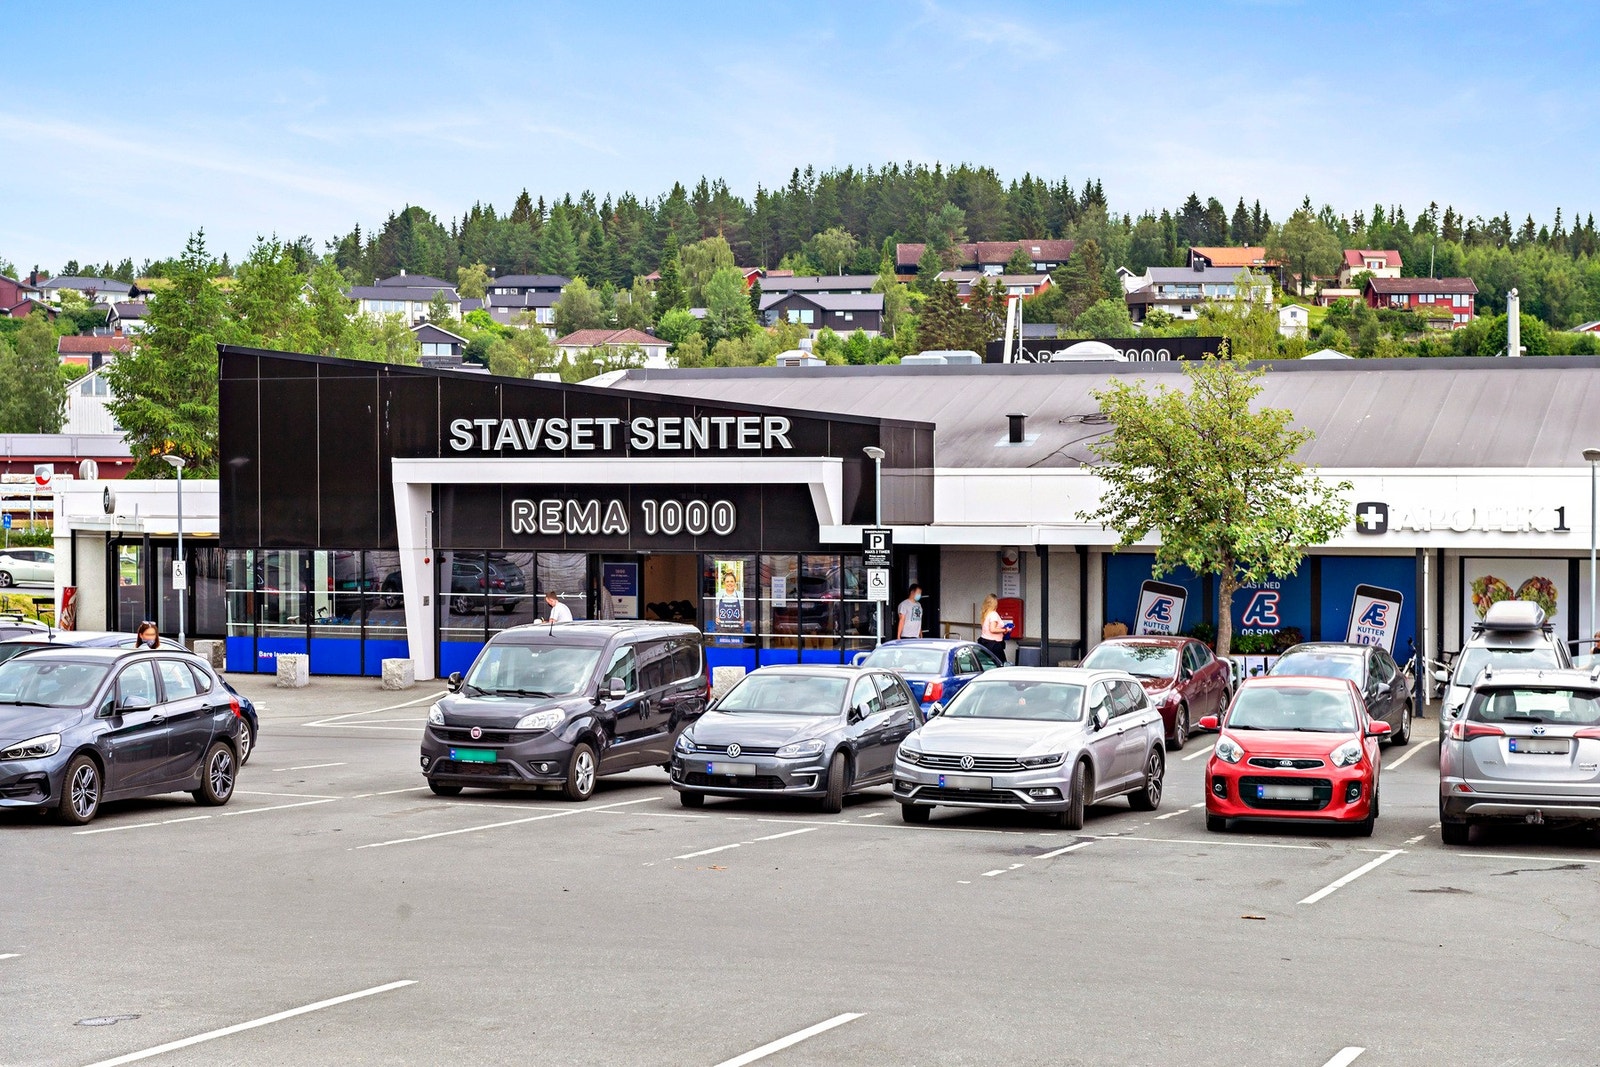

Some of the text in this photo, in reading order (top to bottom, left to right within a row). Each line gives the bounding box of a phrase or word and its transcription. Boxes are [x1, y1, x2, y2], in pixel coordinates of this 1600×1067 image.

[450, 416, 793, 450] STAVSET SENTER
[511, 499, 737, 535] REMA 1000
[1553, 506, 1570, 532] 1
[873, 535, 883, 548] P
[719, 608, 740, 619] 294
[1143, 621, 1170, 630] KUTTER
[1357, 626, 1385, 636] KUTTER
[1356, 634, 1383, 648] 10%
[258, 650, 273, 658] Bare
